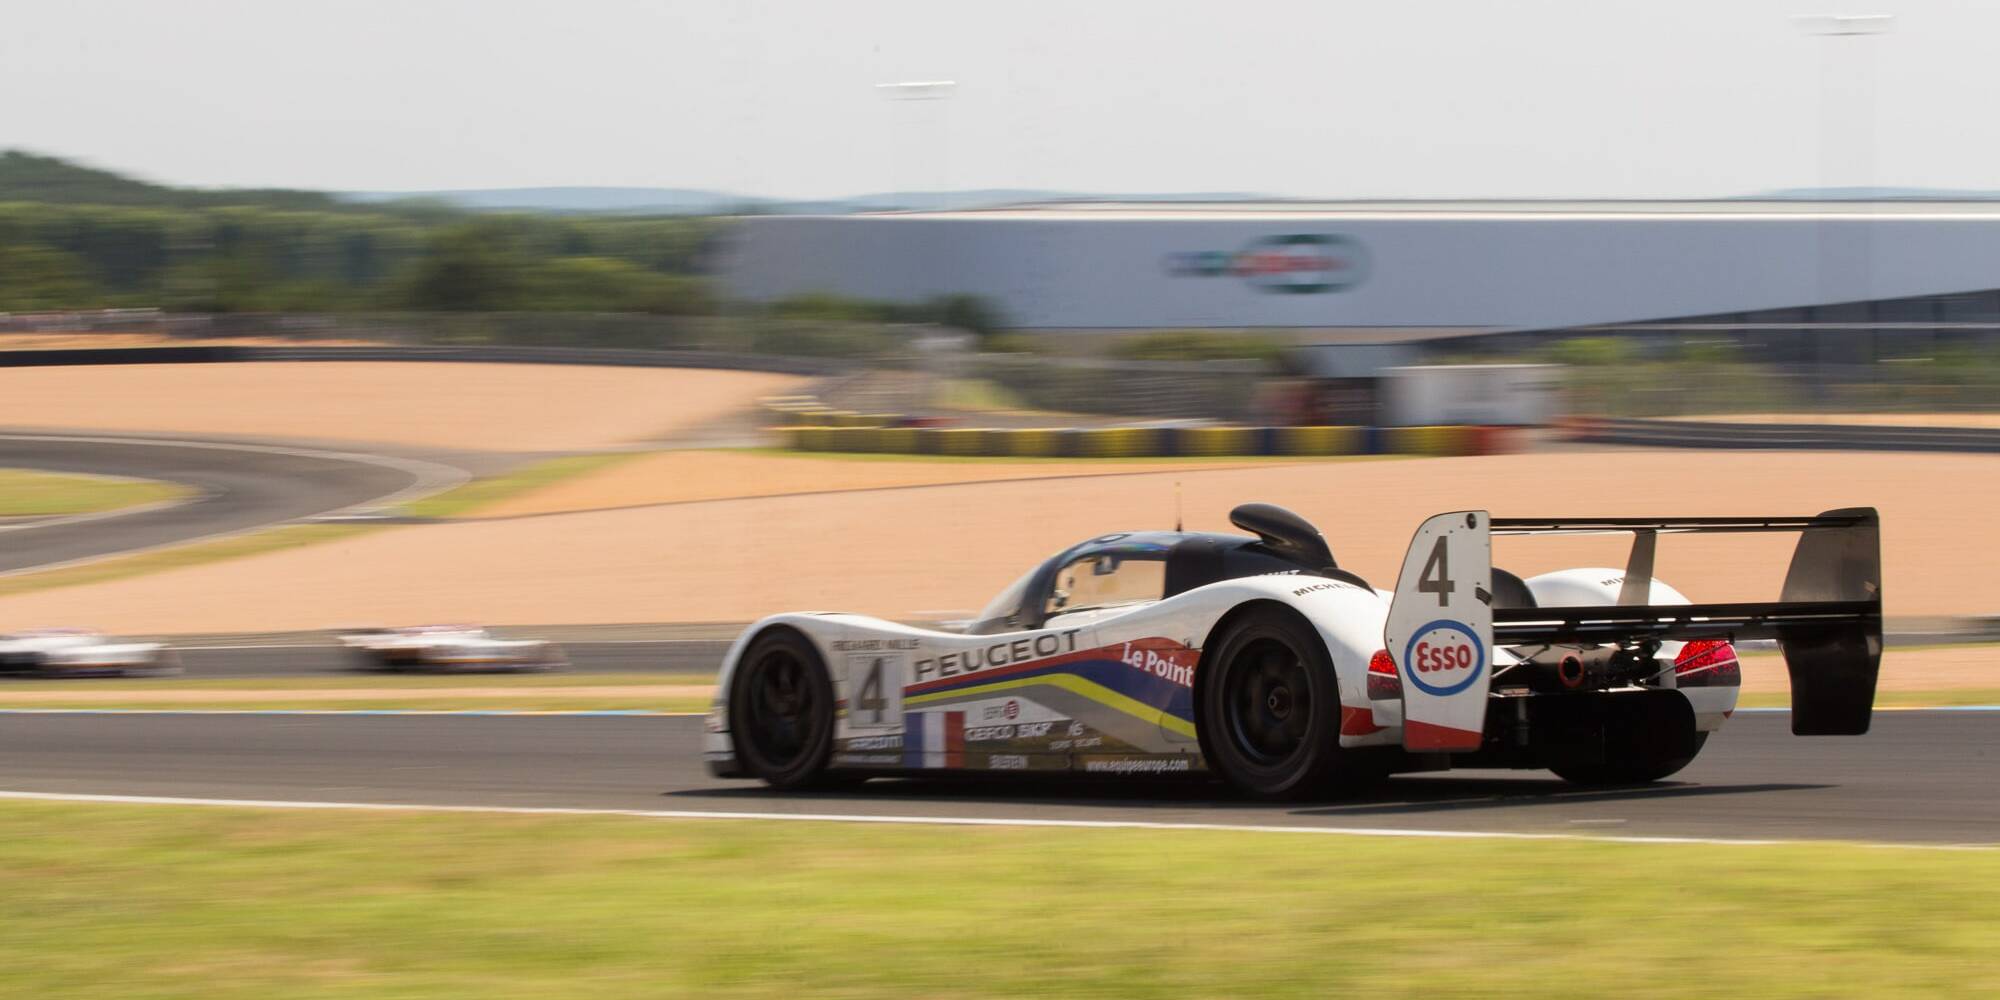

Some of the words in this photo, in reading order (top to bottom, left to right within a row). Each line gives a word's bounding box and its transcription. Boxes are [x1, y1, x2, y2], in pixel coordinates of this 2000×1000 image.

[1419, 535, 1455, 607] 4
[914, 629, 1081, 682] PEUGEOT
[1121, 641, 1144, 668] Le
[1144, 649, 1194, 688] Point
[1417, 642, 1472, 673] Esso
[856, 657, 889, 724] 4
